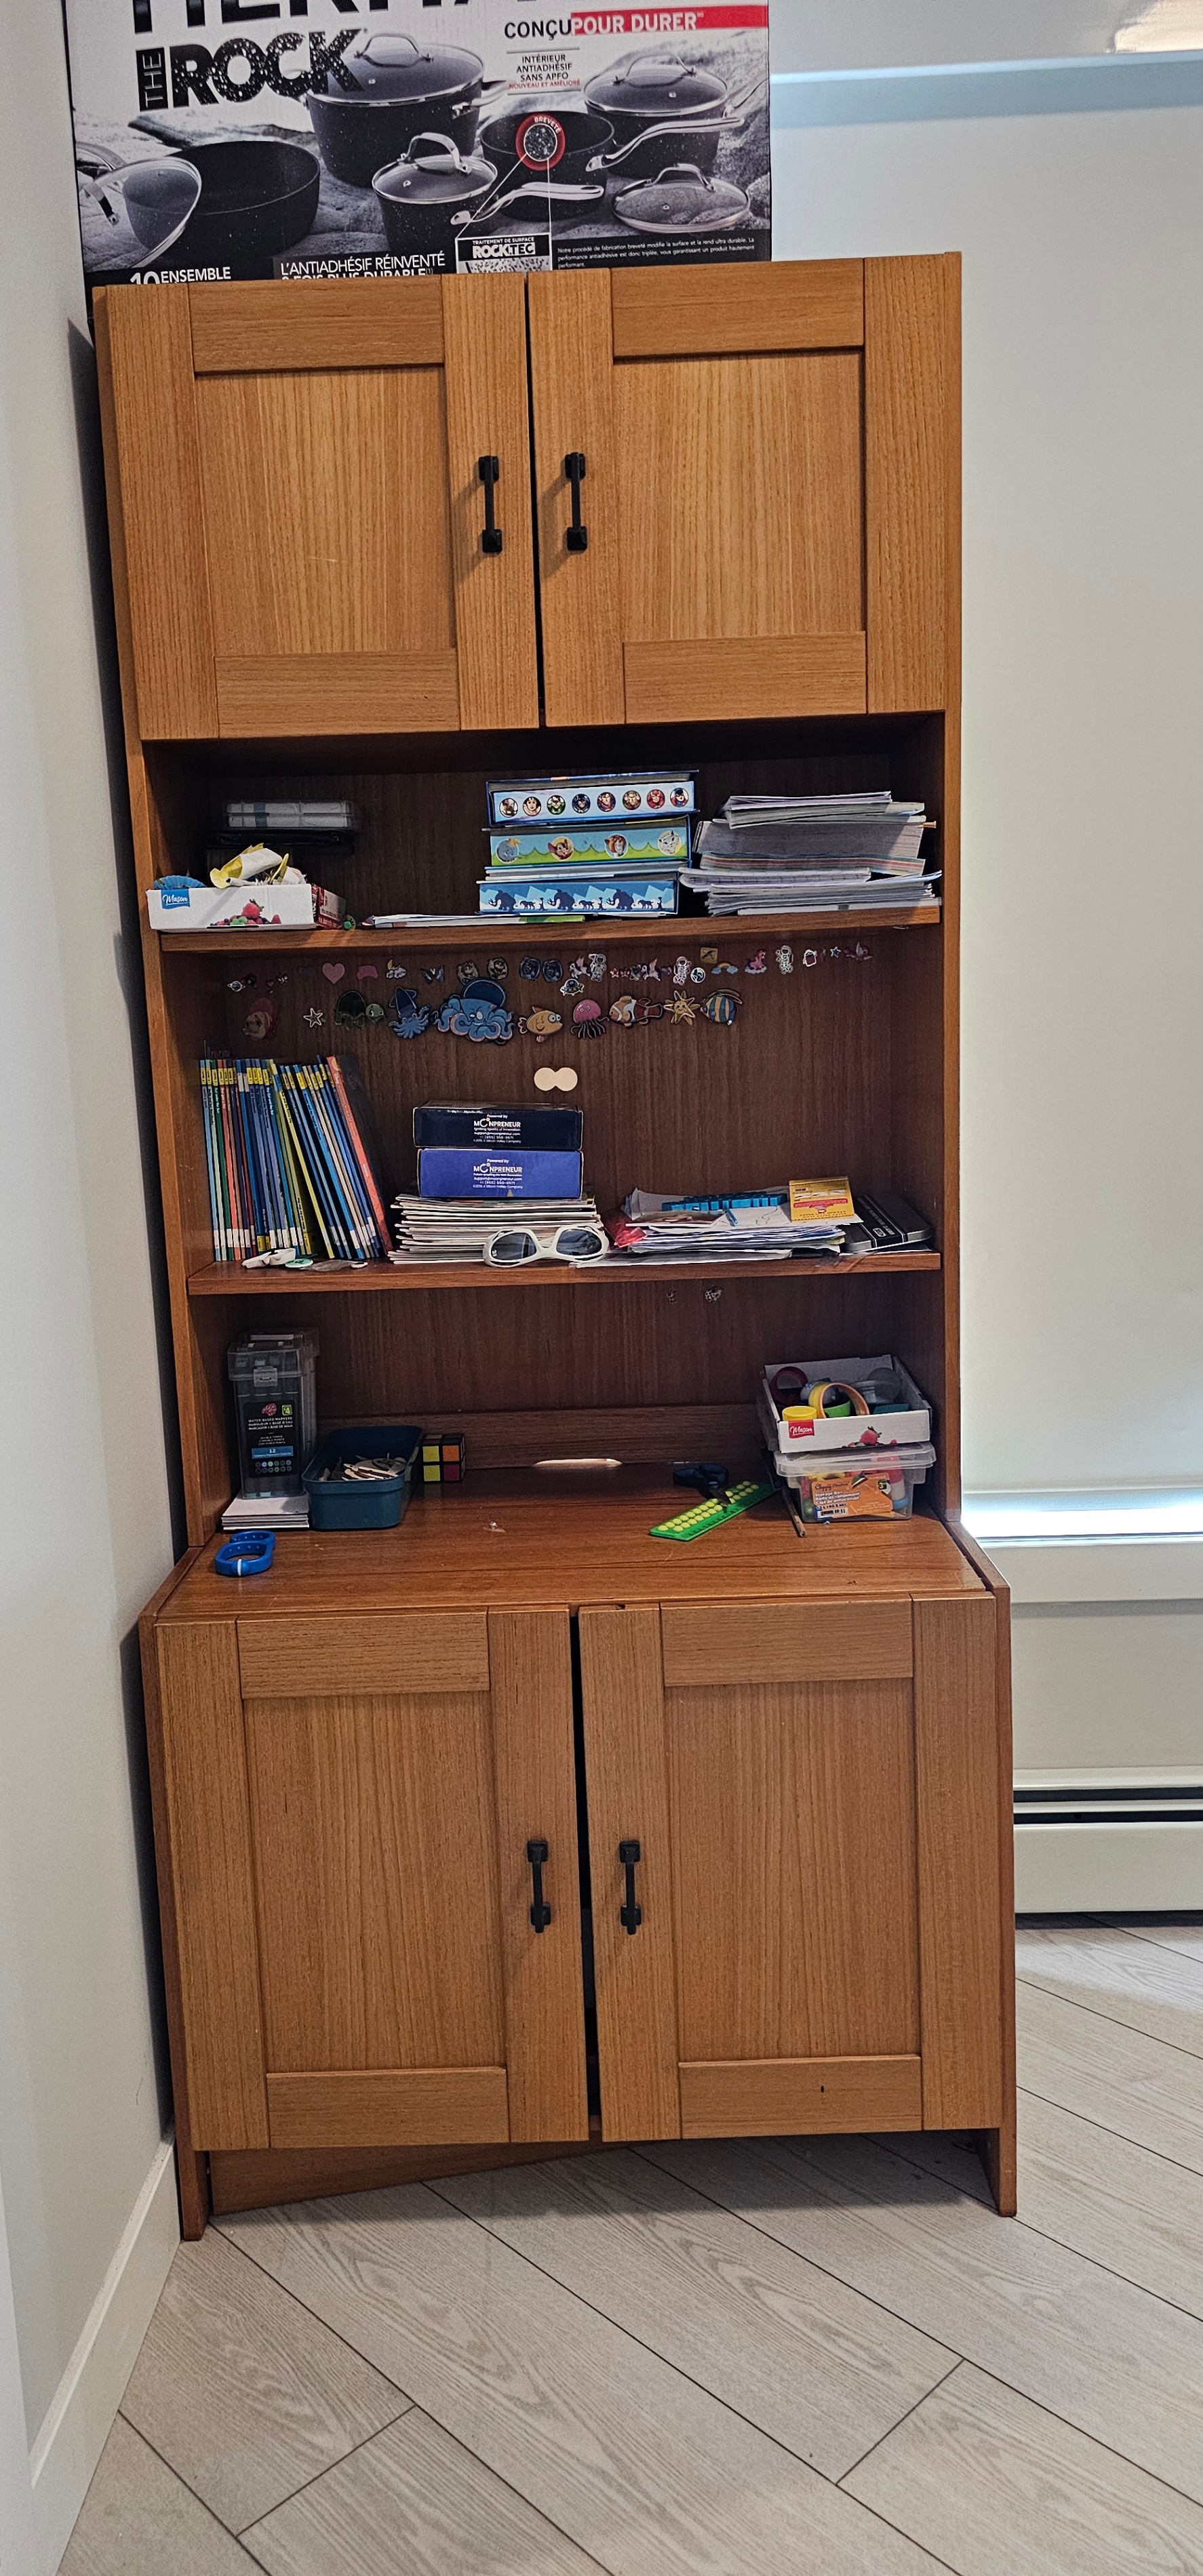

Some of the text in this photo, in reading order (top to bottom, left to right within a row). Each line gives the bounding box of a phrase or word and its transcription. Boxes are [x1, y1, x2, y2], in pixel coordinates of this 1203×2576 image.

[505, 20, 572, 41] CONÇU
[571, 16, 625, 35] POUR
[521, 54, 566, 64] INTÉRIEUR
[169, 28, 364, 108] ROCK
[516, 62, 572, 73] ANTIADHÉSIF
[142, 52, 161, 108] THE
[521, 73, 568, 82] SANS APFO
[509, 81, 539, 89] NOUVEAU
[376, 251, 446, 270] RÉINVENTÉ
[161, 266, 231, 283] ENSEMBLE
[162, 894, 189, 906] Mason
[789, 1426, 813, 1436] Mason
